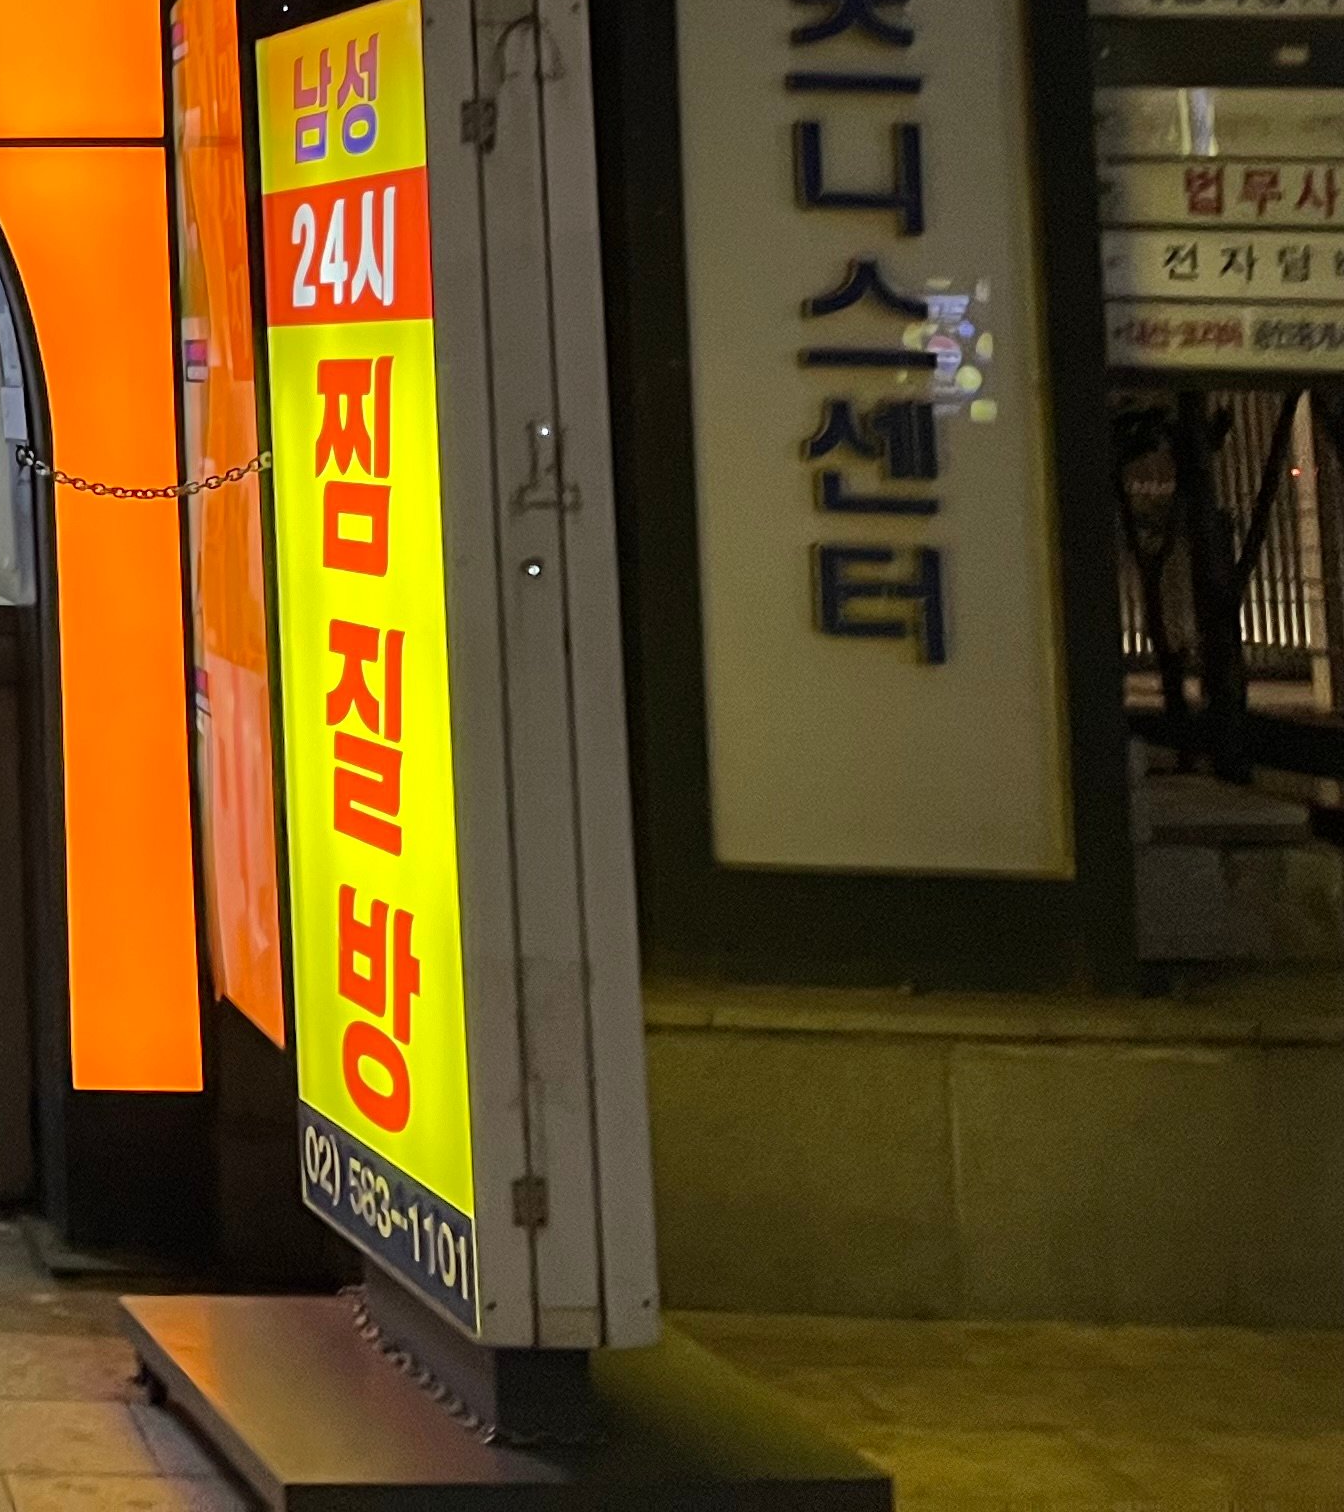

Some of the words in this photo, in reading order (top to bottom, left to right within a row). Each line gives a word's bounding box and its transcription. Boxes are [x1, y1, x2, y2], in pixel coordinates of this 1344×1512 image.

[293, 32, 380, 164] 남성
[292, 186, 396, 308] 24시
[316, 356, 420, 1132] 찜질방
[304, 1125, 341, 1207] 02)
[348, 1156, 469, 1300] 583-1101
